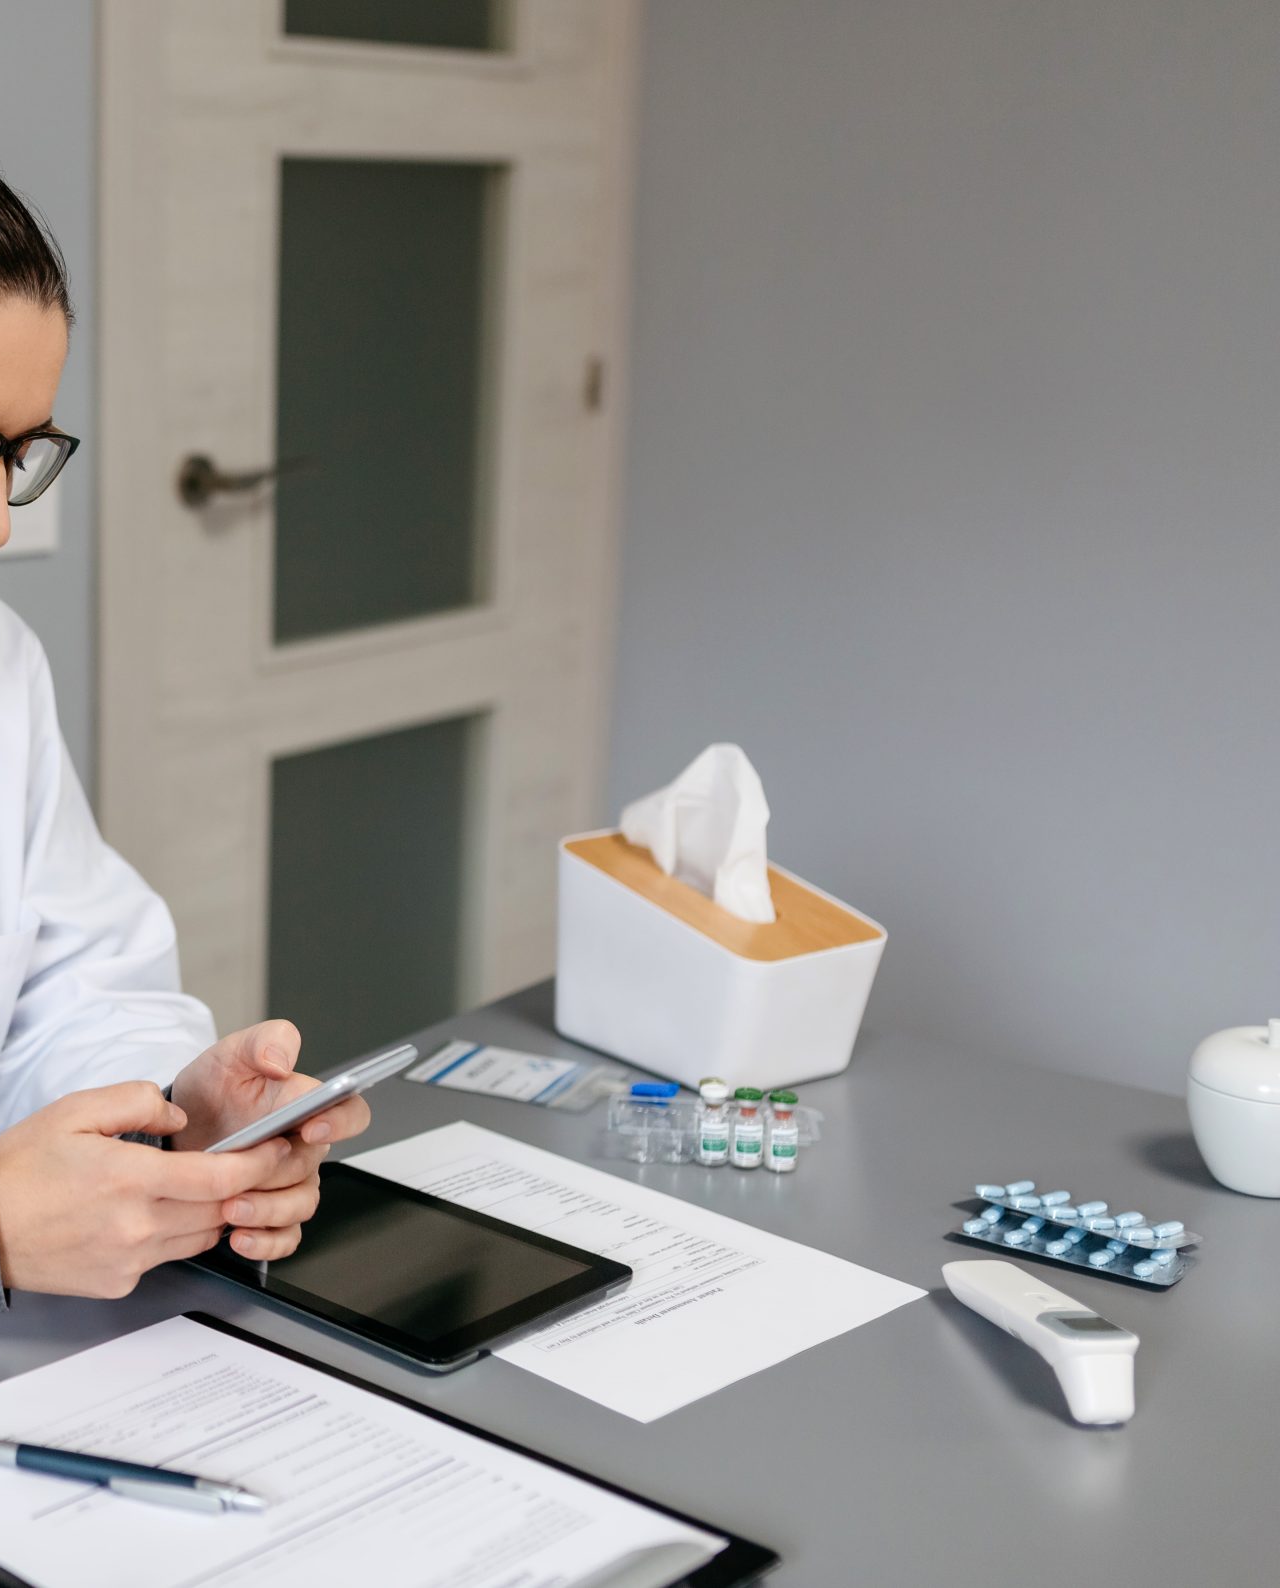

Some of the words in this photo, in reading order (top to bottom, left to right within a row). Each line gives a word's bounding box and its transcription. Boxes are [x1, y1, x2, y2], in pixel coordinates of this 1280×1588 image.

[697, 1287, 724, 1300] Patient
[659, 1297, 698, 1315] Assessment
[634, 1312, 661, 1326] Details
